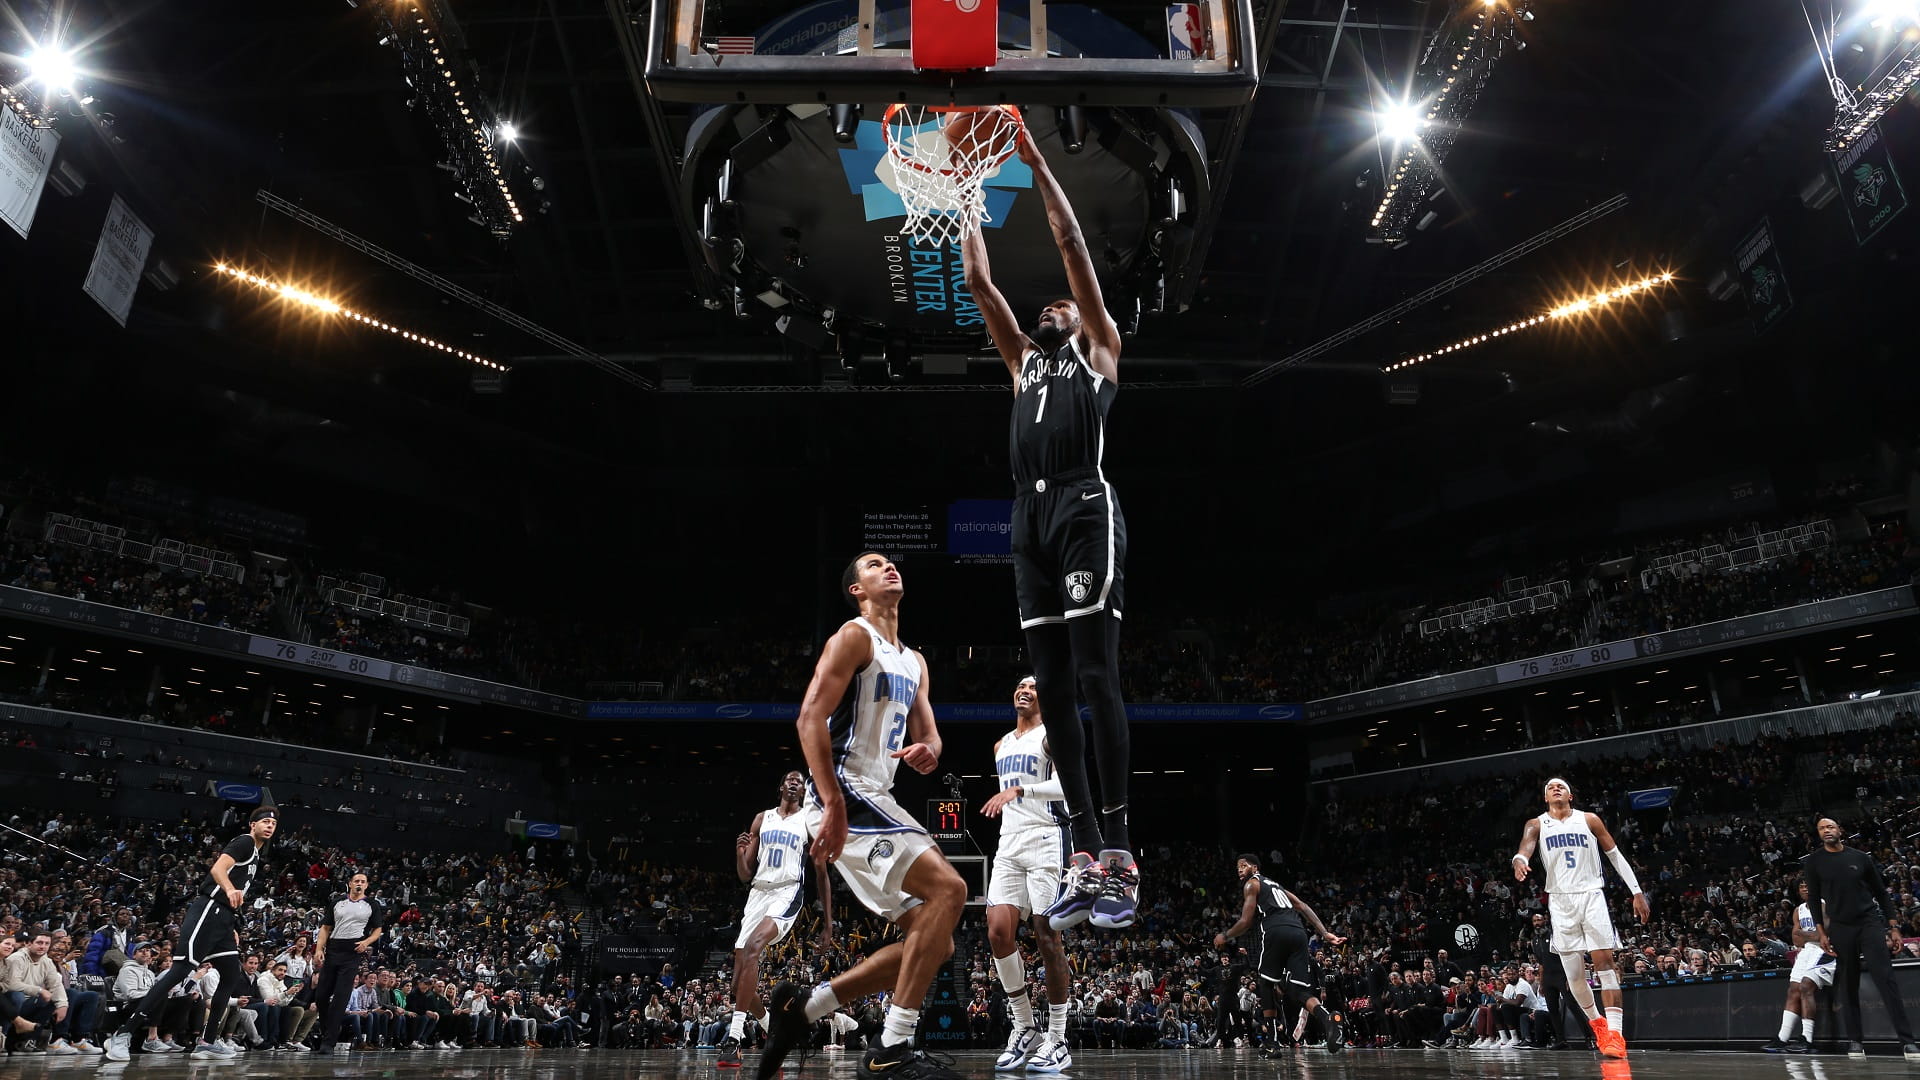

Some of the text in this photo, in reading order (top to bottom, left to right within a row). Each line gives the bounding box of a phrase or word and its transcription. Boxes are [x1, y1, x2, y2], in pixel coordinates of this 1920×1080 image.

[1175, 49, 1192, 60] NBA
[4, 115, 47, 165] BASKETBALL
[1837, 127, 1878, 175] CHAMPIONS
[1868, 205, 1891, 228] 2000
[119, 214, 141, 242] NETS
[109, 220, 143, 262] BASKETBALL
[884, 235, 909, 303] BROOKLYN
[908, 234, 947, 314] CENTER
[1035, 384, 1048, 424] 7
[1066, 573, 1091, 588] NETS
[276, 643, 297, 659] 76
[311, 649, 335, 663] 2:07
[1552, 654, 1575, 666] 2:07
[1591, 647, 1611, 663] 80
[348, 658, 368, 673] 80
[1519, 662, 1539, 676] 76
[591, 704, 612, 713] More
[613, 704, 632, 714] than
[632, 705, 648, 717] just
[1134, 706, 1155, 716] More
[886, 712, 906, 752] 2
[996, 754, 1039, 777] MAGIC
[938, 802, 960, 813] 2:07
[942, 813, 957, 830] 17
[760, 829, 801, 851] MAGIC
[1545, 833, 1589, 851] MAGIC
[767, 847, 783, 868] 10
[1564, 850, 1577, 869] 5
[1271, 887, 1293, 909] 00
[925, 1031, 967, 1041] BARCLAYS
